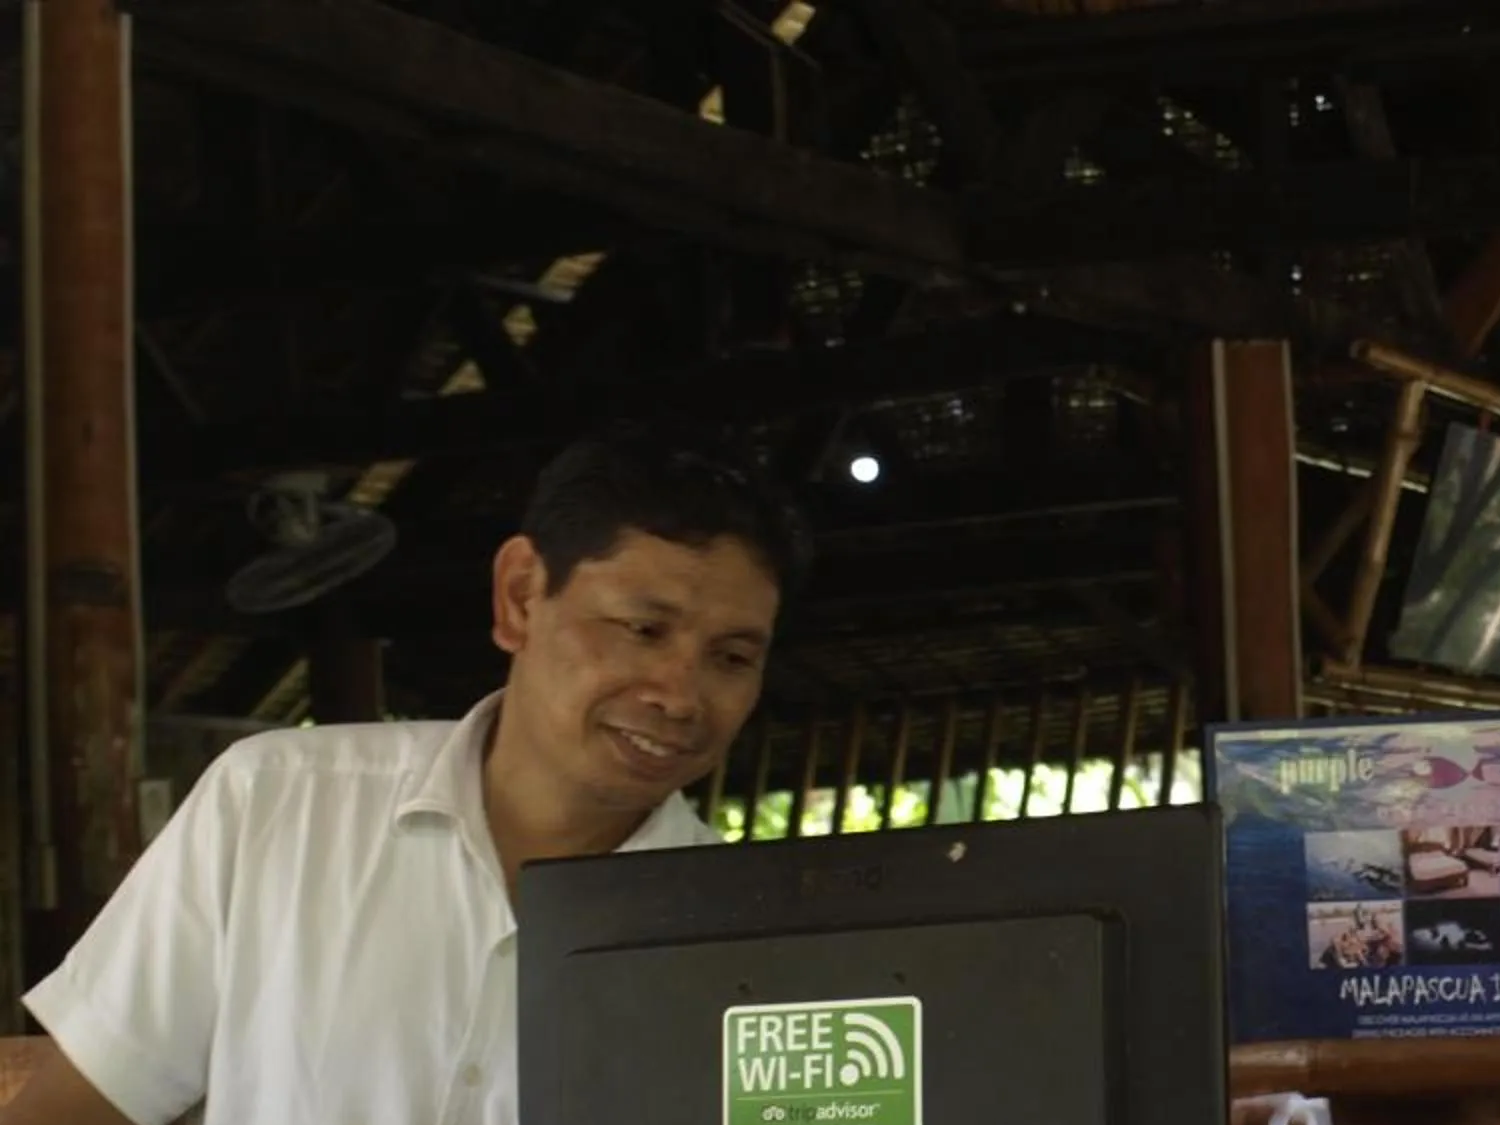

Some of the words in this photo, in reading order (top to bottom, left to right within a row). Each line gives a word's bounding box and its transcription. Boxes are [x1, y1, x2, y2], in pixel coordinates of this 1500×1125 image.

[1279, 749, 1374, 795] purple
[1340, 974, 1486, 1006] MALAPASCUA
[737, 1012, 833, 1053] FREE
[738, 1053, 833, 1092] WI-FI
